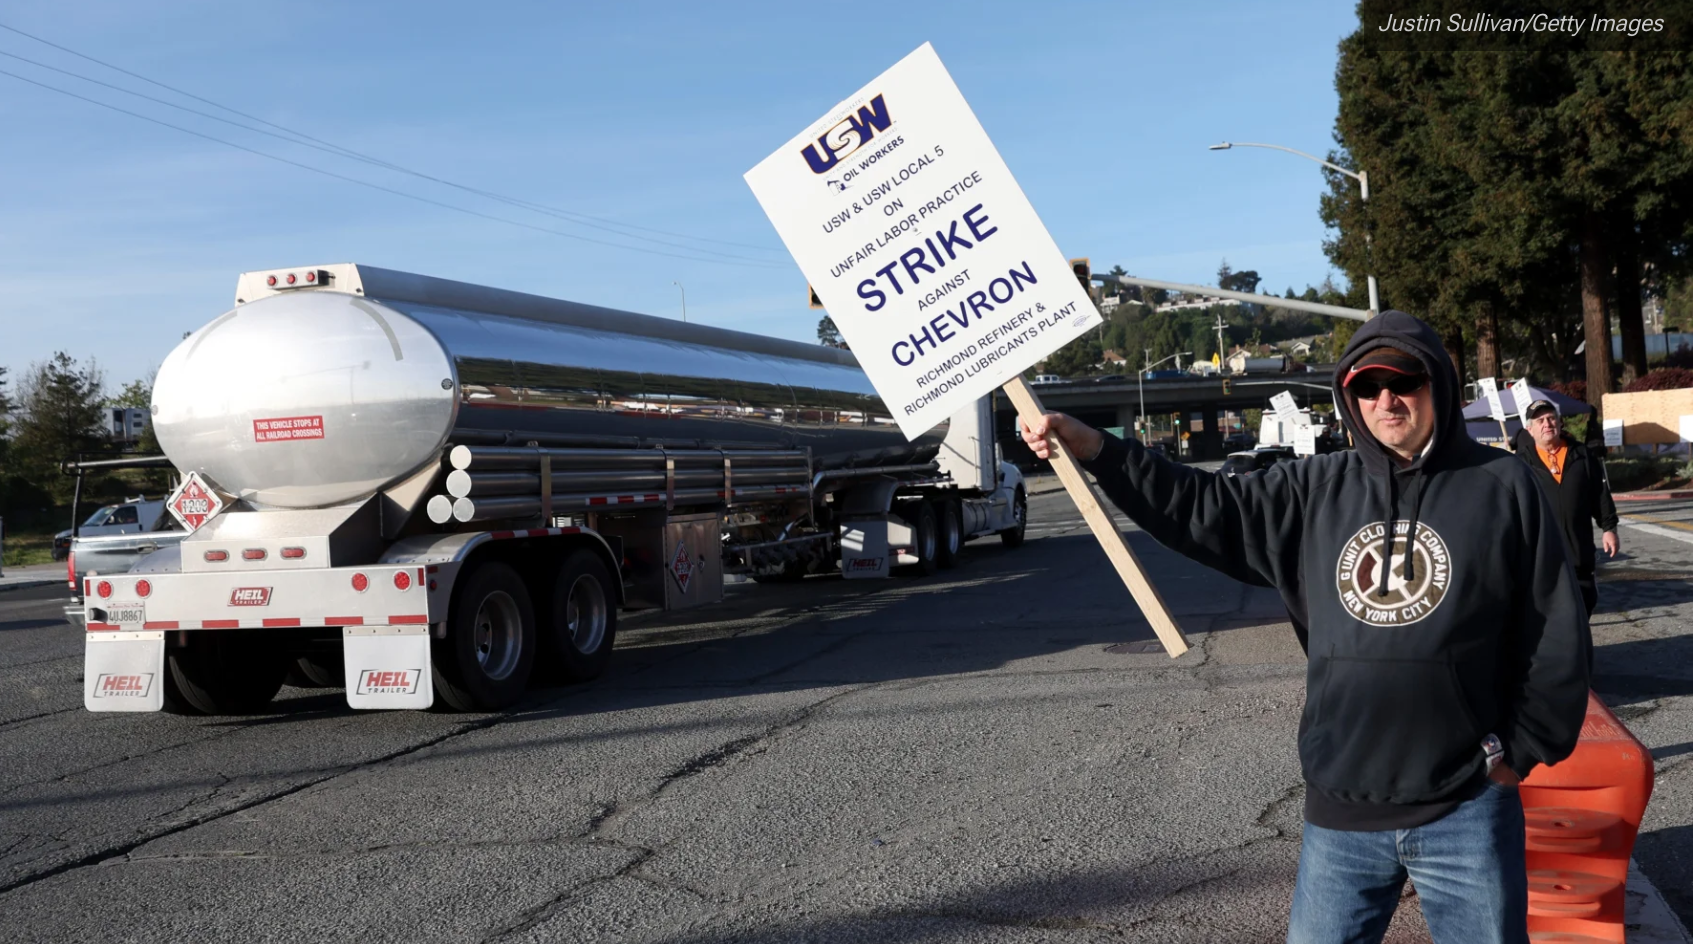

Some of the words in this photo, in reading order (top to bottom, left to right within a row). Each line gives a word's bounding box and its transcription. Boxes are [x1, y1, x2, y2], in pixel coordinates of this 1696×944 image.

[800, 92, 892, 175] USW
[843, 168, 860, 182] OIL
[858, 135, 905, 171] WORKERS
[822, 208, 851, 234] USW
[852, 202, 864, 214] &
[862, 180, 892, 206] USW
[891, 154, 935, 186] LOCAL
[934, 144, 944, 157] 5
[883, 198, 904, 217] ON
[830, 242, 877, 278] UNFAIR
[875, 213, 920, 248] LABOR
[918, 170, 983, 219] PRACTICE
[856, 203, 998, 312] STRIKE
[918, 268, 972, 312] AGAINST
[891, 260, 1038, 367] CHEVRON
[903, 373, 965, 416] RICHMOND
[964, 327, 1038, 378] LUBRICANTS
[1038, 301, 1077, 332] PLANT
[916, 344, 978, 388] RICHMOND
[977, 308, 1034, 350] REFINERY
[1036, 302, 1046, 313] &
[256, 422, 269, 430] THIS
[269, 420, 293, 429] VEHICLE
[293, 419, 312, 428] STOPS
[313, 418, 320, 426] AT
[256, 432, 266, 440] ALL
[266, 430, 292, 439] RAILROAD
[292, 428, 322, 438] CROSSINGS
[853, 558, 877, 567] HEIL
[1341, 541, 1360, 570] UNIT
[1420, 530, 1447, 590] COMPANY
[1340, 572, 1351, 580] G
[234, 589, 264, 600] HEIL
[1343, 590, 1364, 613] NEW
[1365, 607, 1397, 622] YORK
[1402, 597, 1432, 620] CITY
[109, 610, 143, 622] 4UJ8867
[103, 675, 142, 691] HEIL
[366, 671, 410, 687] HEIL
